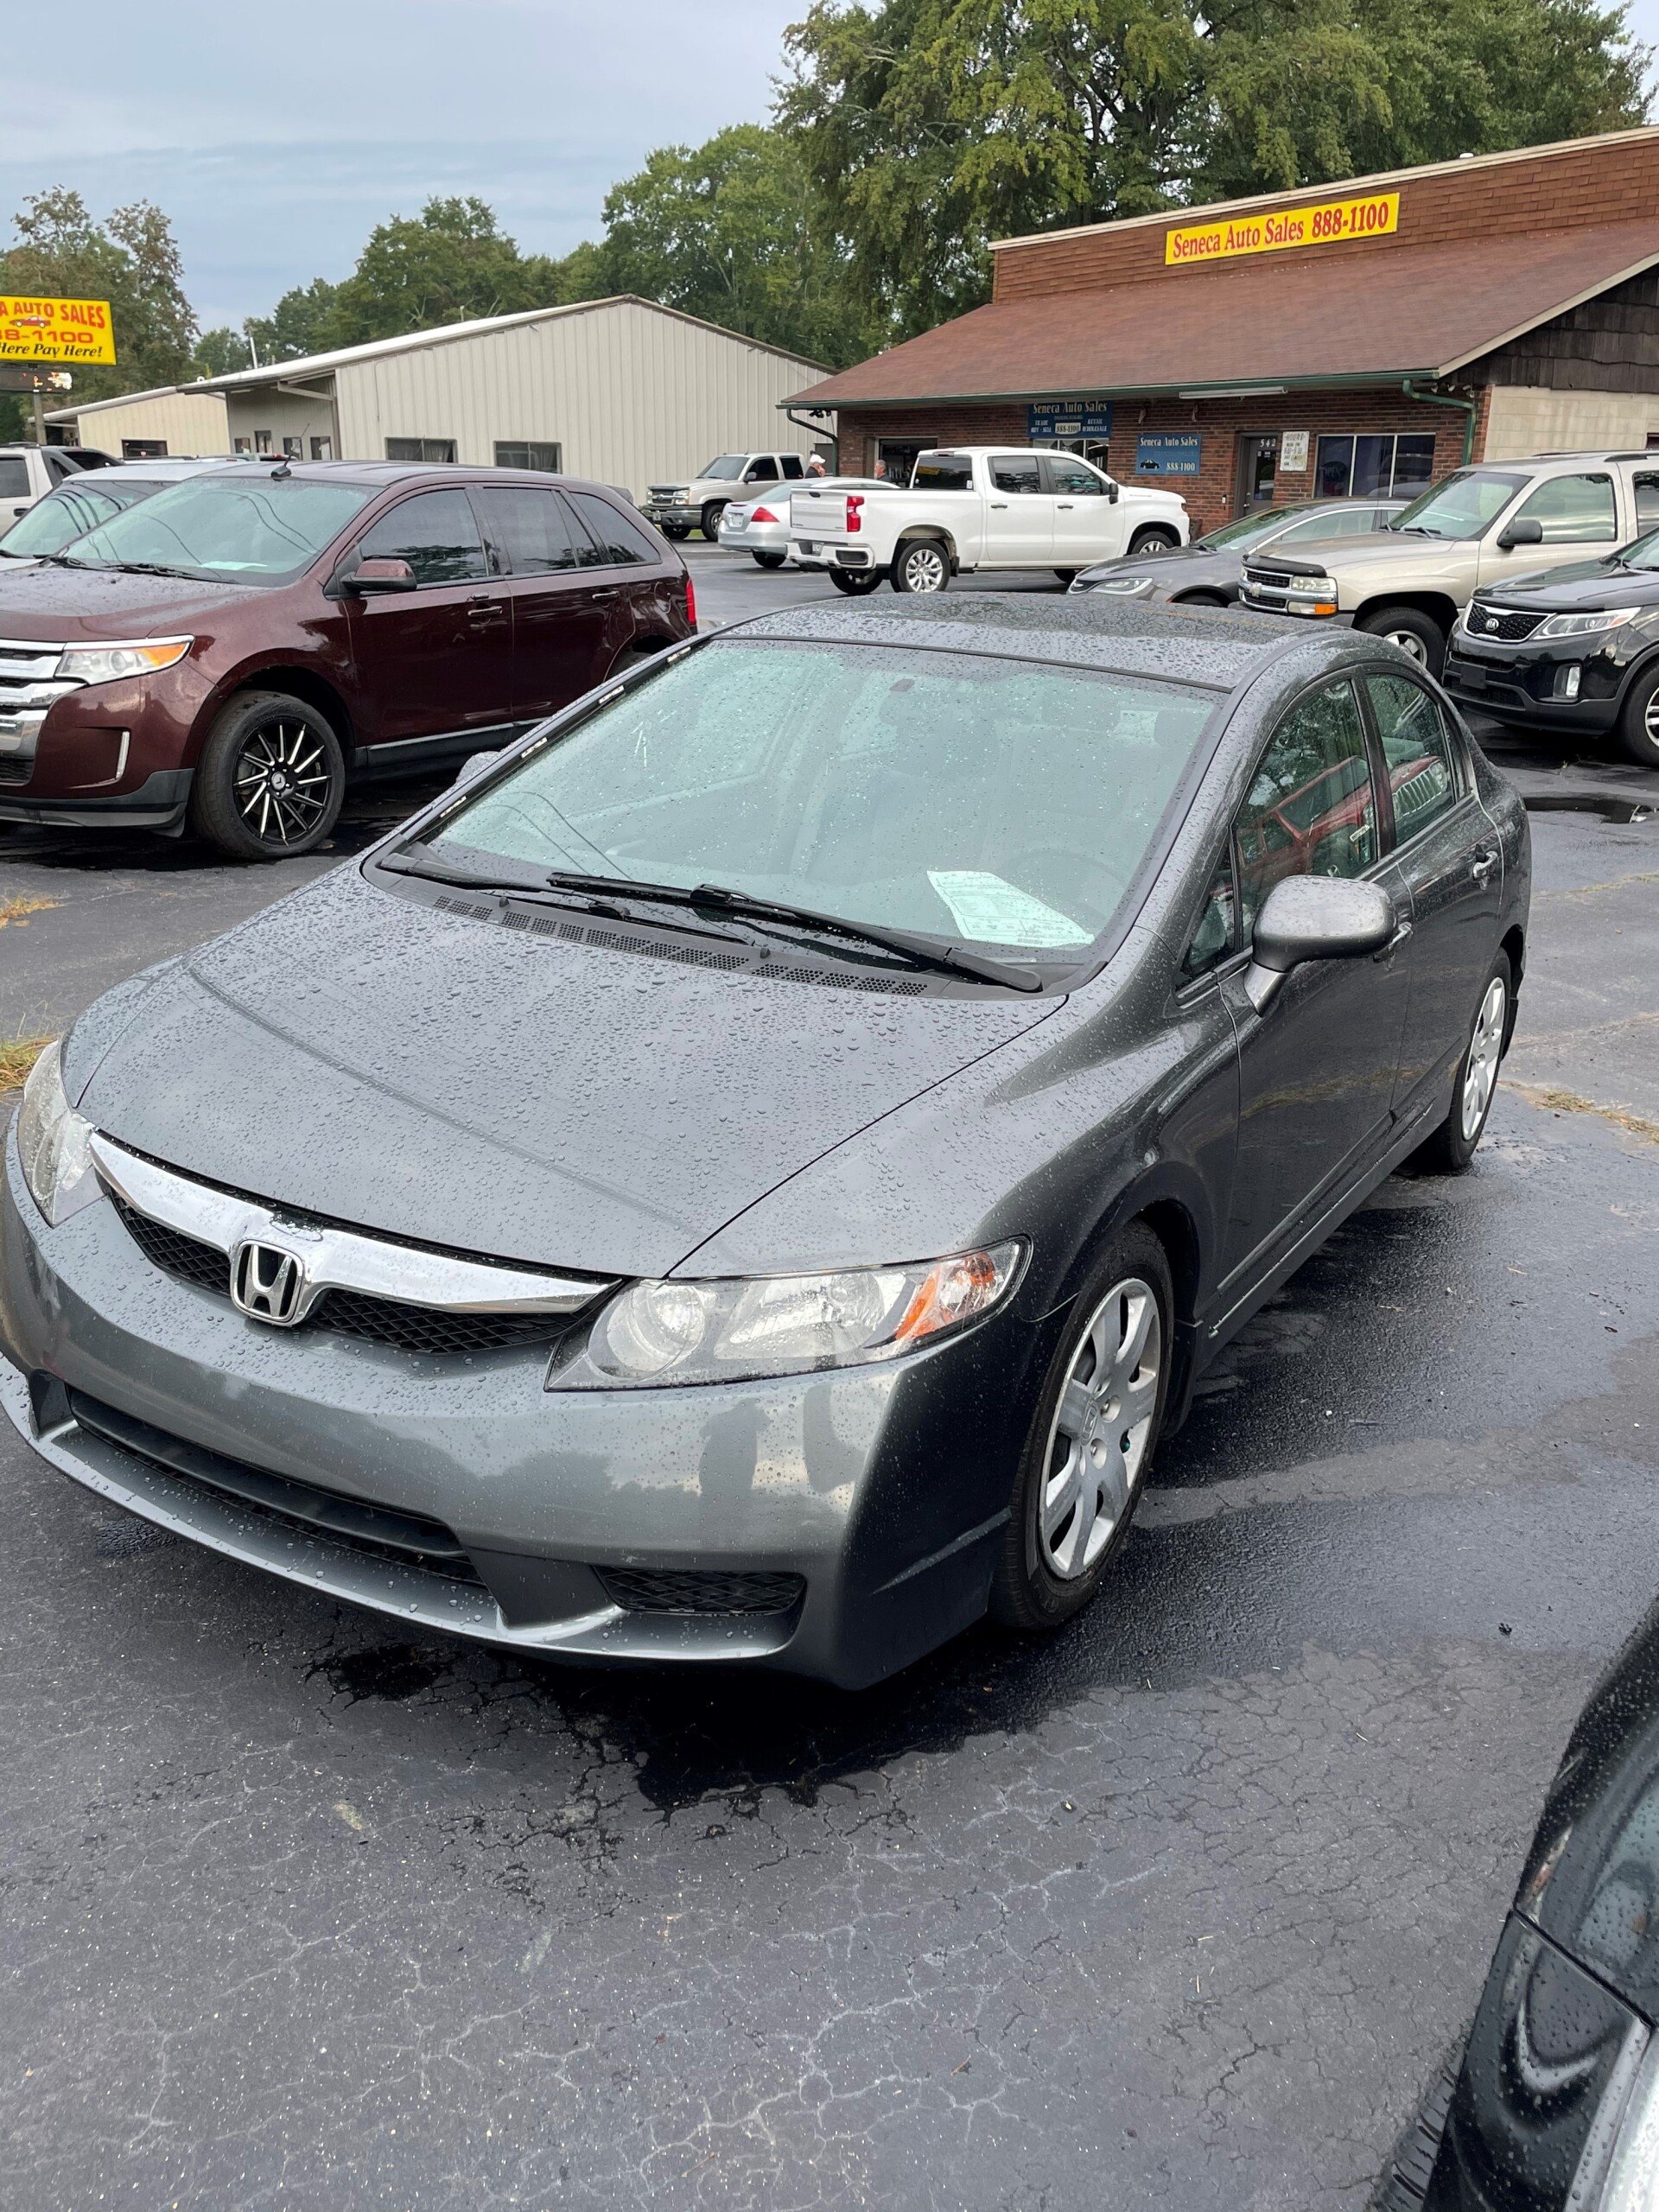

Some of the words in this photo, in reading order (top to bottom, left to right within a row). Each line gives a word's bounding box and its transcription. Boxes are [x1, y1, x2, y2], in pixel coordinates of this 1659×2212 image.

[1173, 232, 1221, 258] Seneca
[1224, 225, 1261, 251] Auto
[1264, 216, 1304, 245] Sales
[1311, 201, 1389, 238] 888-1100
[14, 302, 54, 318] AUTO
[60, 304, 105, 328] SALES
[0, 329, 93, 344] 8-1100
[34, 343, 60, 358] Pay
[64, 345, 103, 357] Here!
[1033, 404, 1059, 414] Seneca
[1063, 402, 1083, 413] Auto
[1084, 401, 1108, 412] Sales
[1140, 437, 1161, 447] Seneca
[1165, 437, 1179, 447] Auto
[1180, 436, 1198, 446] Sales
[1259, 438, 1276, 448] 542
[1166, 462, 1195, 471] 888-1100
